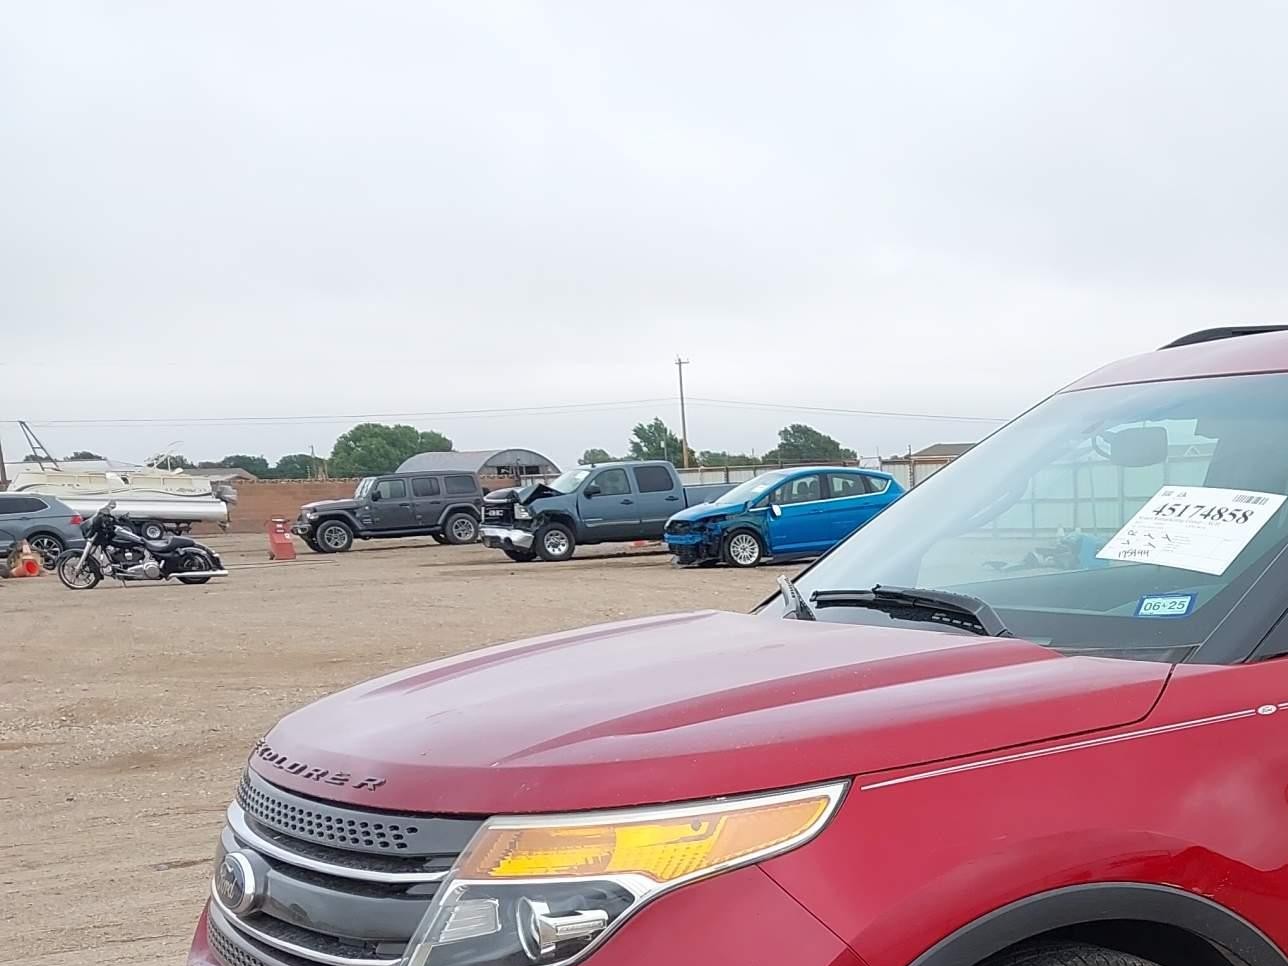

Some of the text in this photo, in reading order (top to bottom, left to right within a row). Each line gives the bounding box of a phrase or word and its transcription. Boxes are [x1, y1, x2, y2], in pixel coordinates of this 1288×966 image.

[1152, 502, 1254, 525] 45174858
[1143, 600, 1187, 611] 06 25
